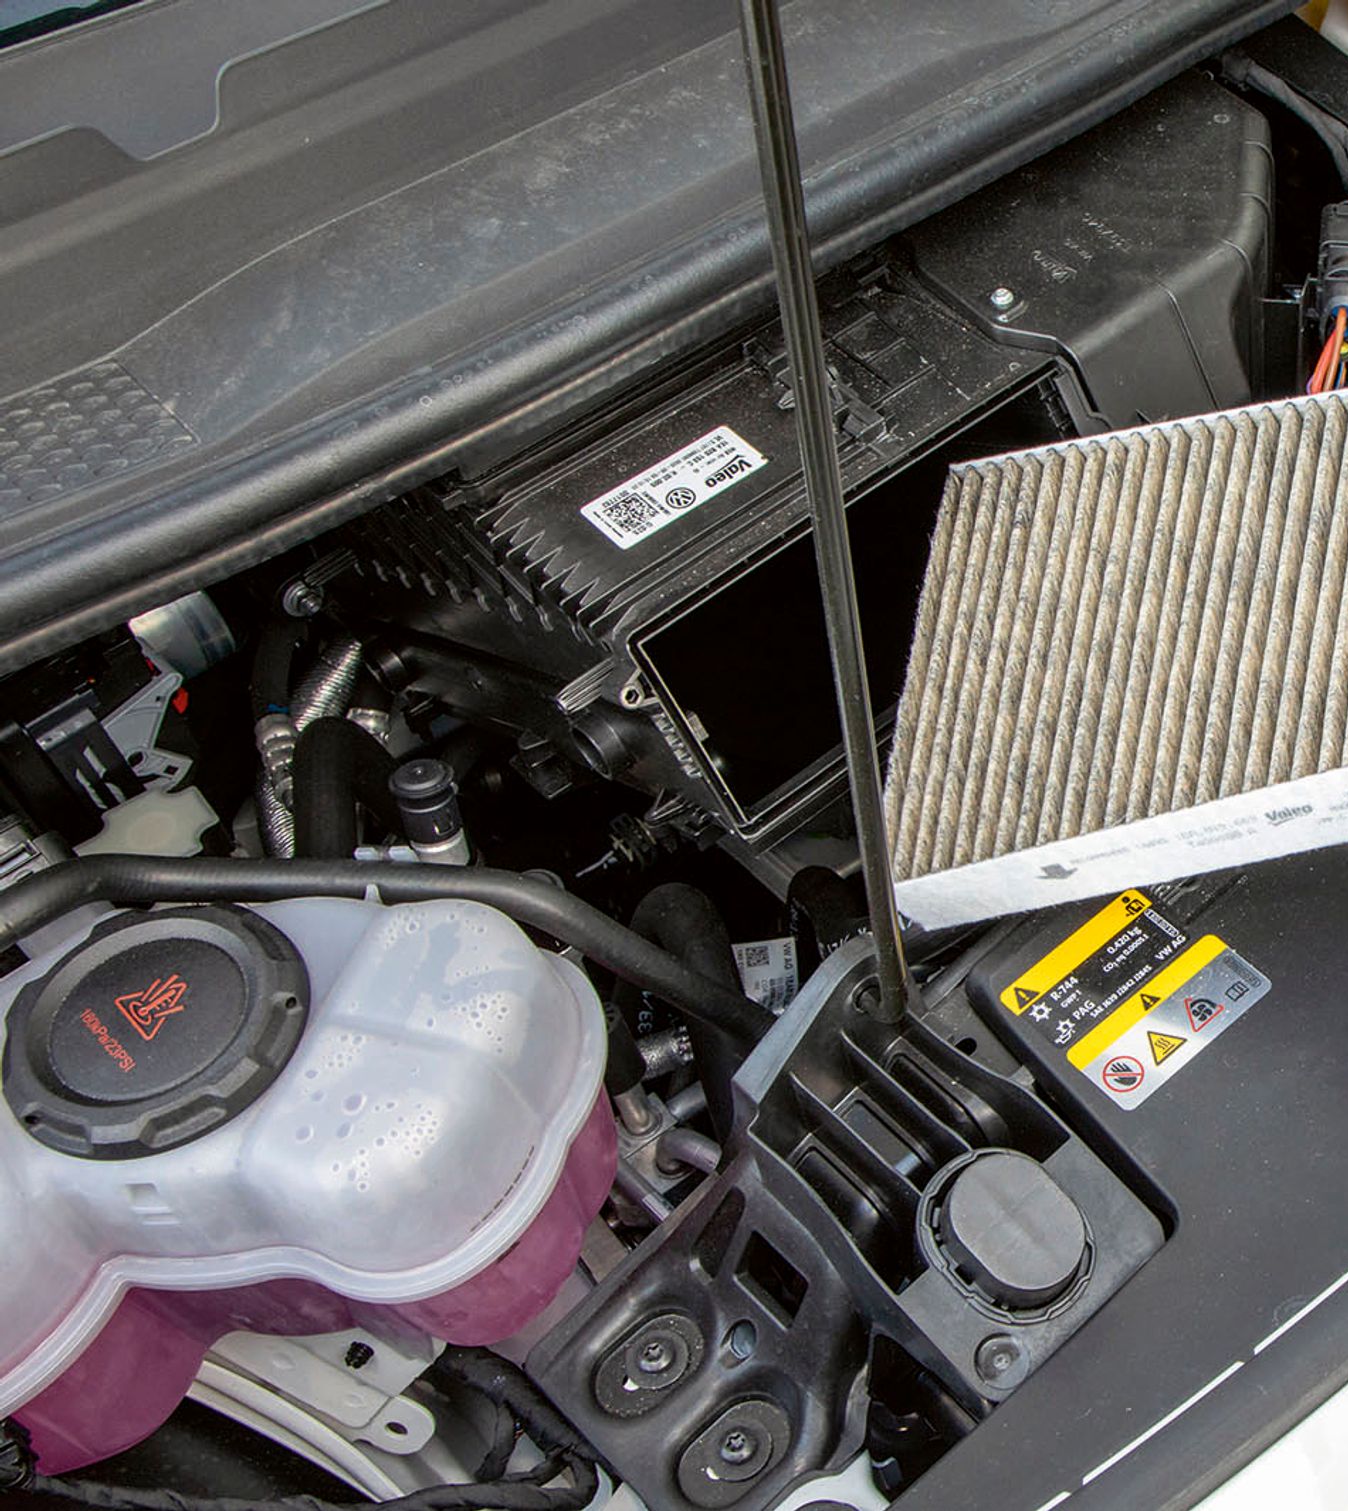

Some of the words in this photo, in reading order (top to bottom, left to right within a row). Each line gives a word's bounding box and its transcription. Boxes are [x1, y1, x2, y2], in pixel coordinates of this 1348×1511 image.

[705, 459, 753, 488] Valeo
[1264, 803, 1314, 824] Valeo
[1154, 944, 1173, 961] VW
[1171, 934, 1187, 949] AG
[1049, 976, 1079, 1001] R-744
[1072, 999, 1097, 1020] PAG
